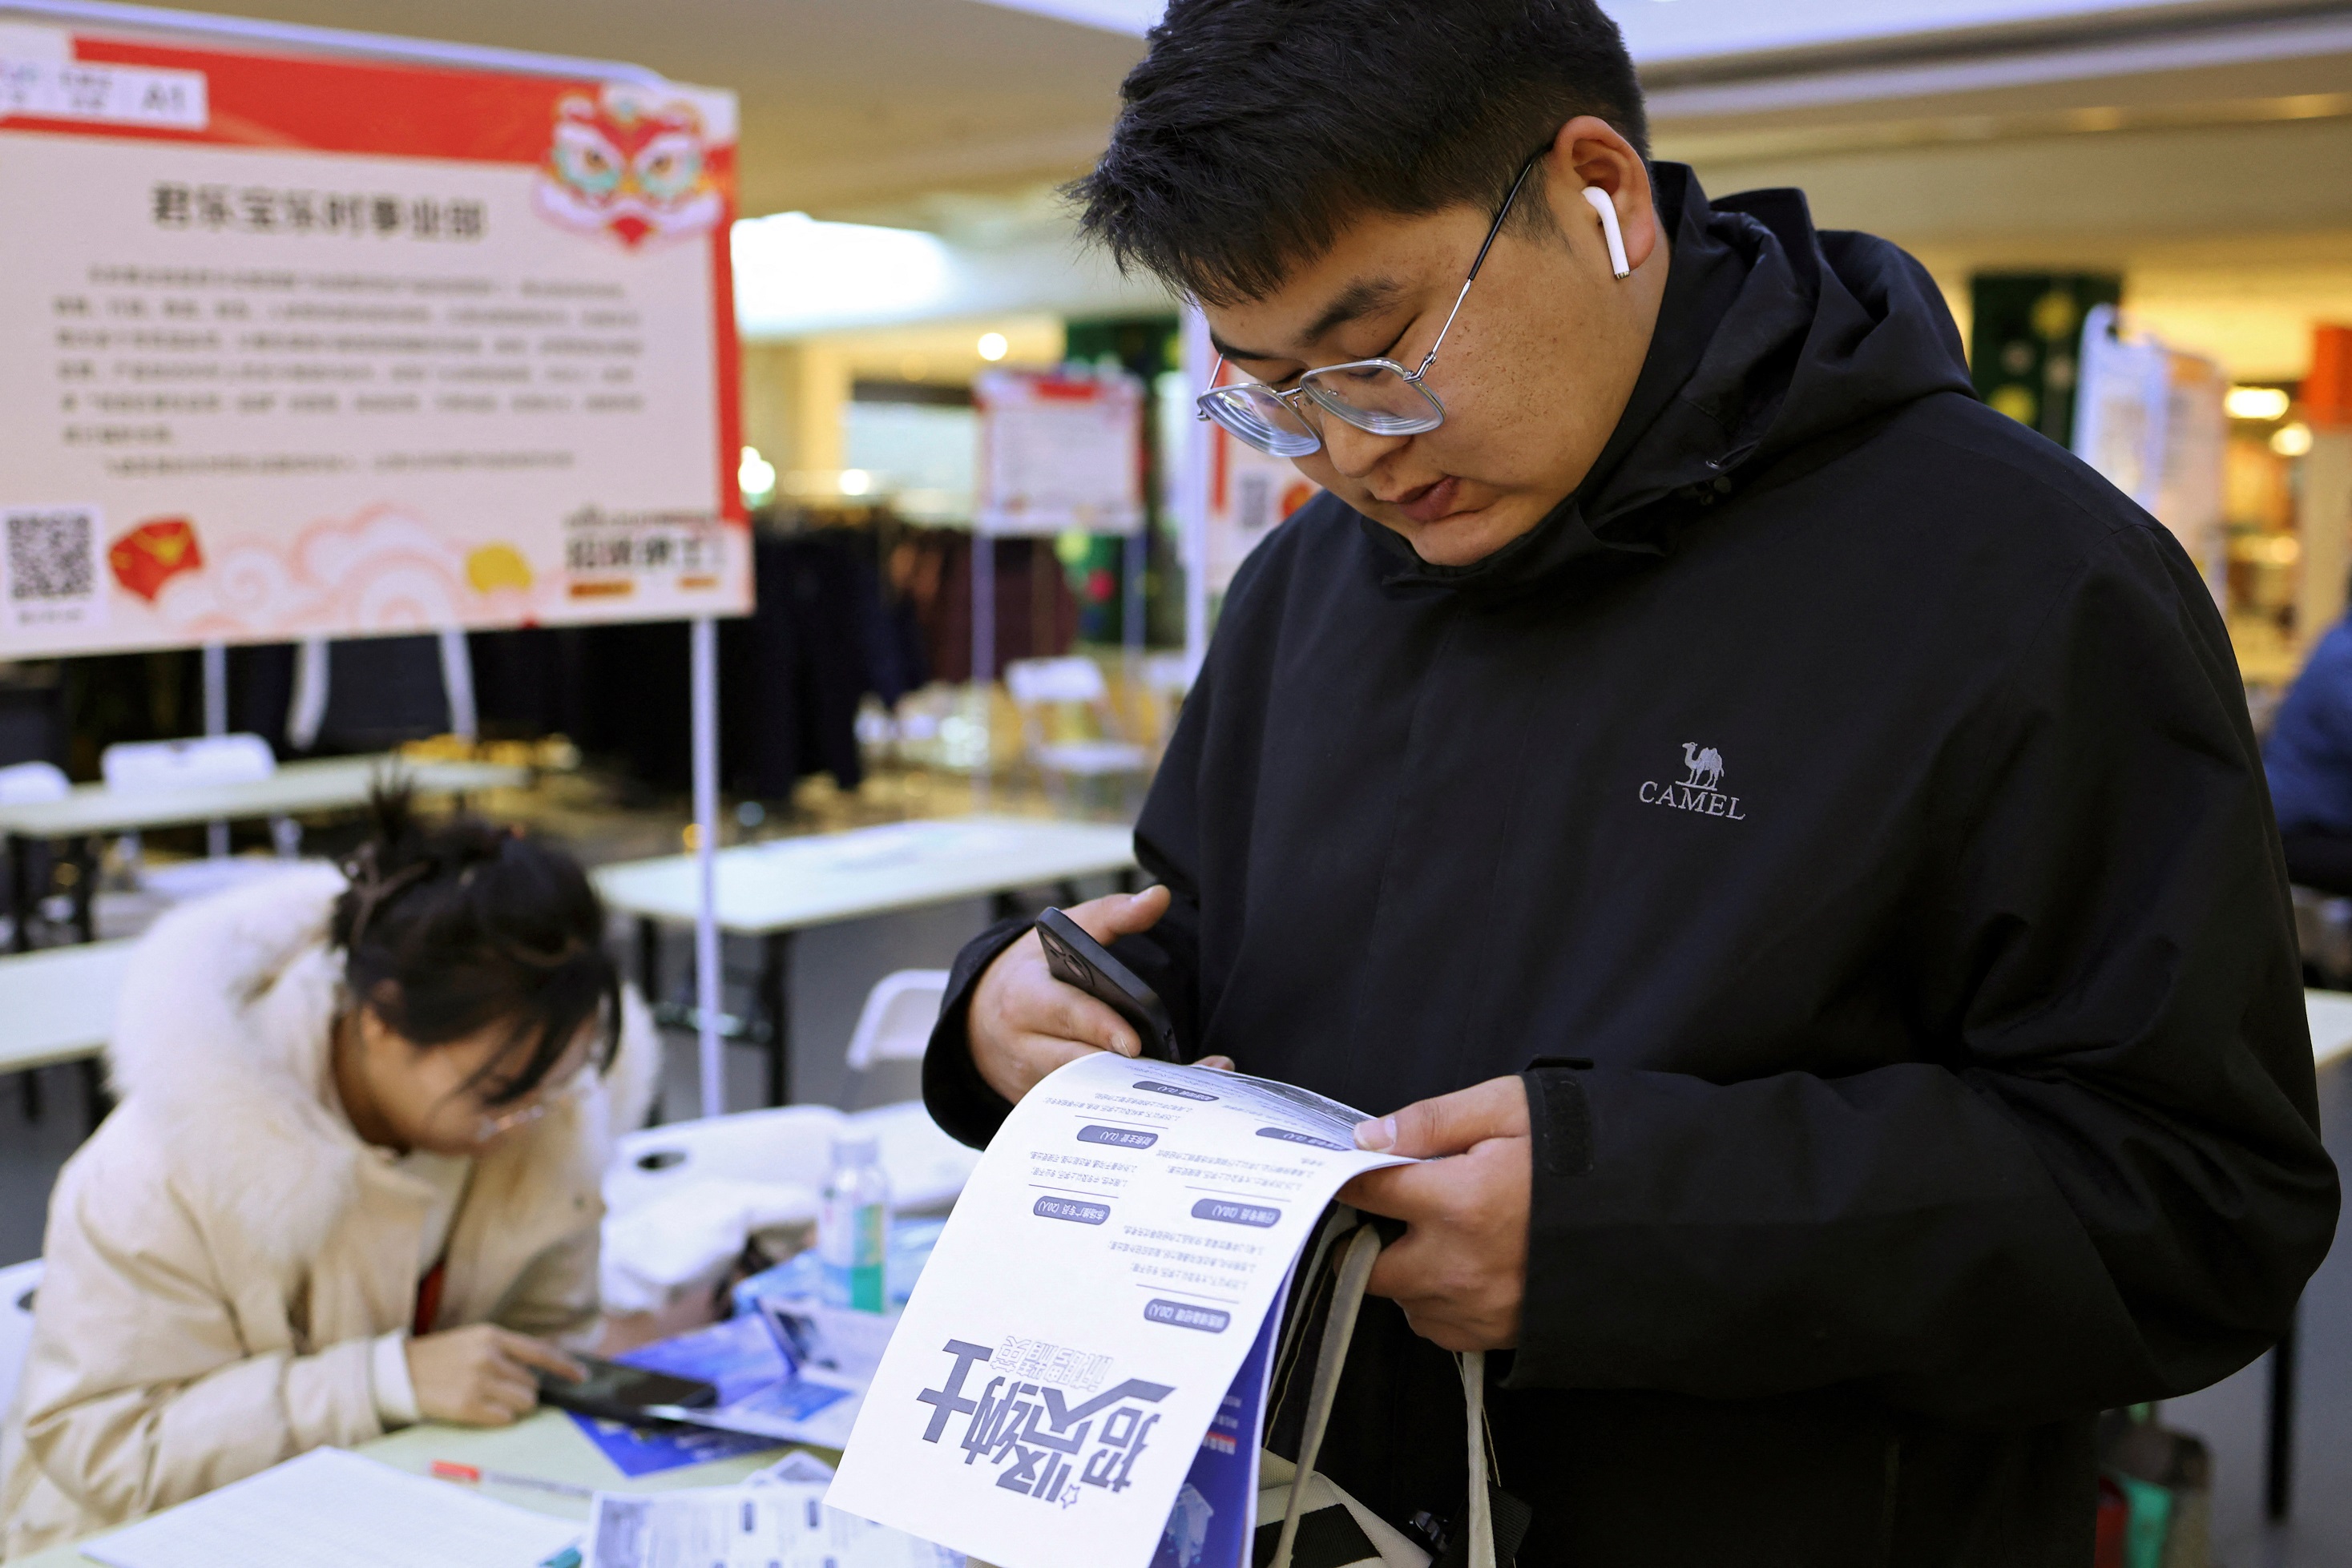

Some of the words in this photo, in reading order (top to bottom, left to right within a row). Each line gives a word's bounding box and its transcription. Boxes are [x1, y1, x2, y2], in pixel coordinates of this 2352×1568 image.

[1639, 780, 1746, 820] CAMEL
[990, 1335, 1114, 1393] 诚聘精英
[916, 1338, 1177, 1502] 招贤纳士
